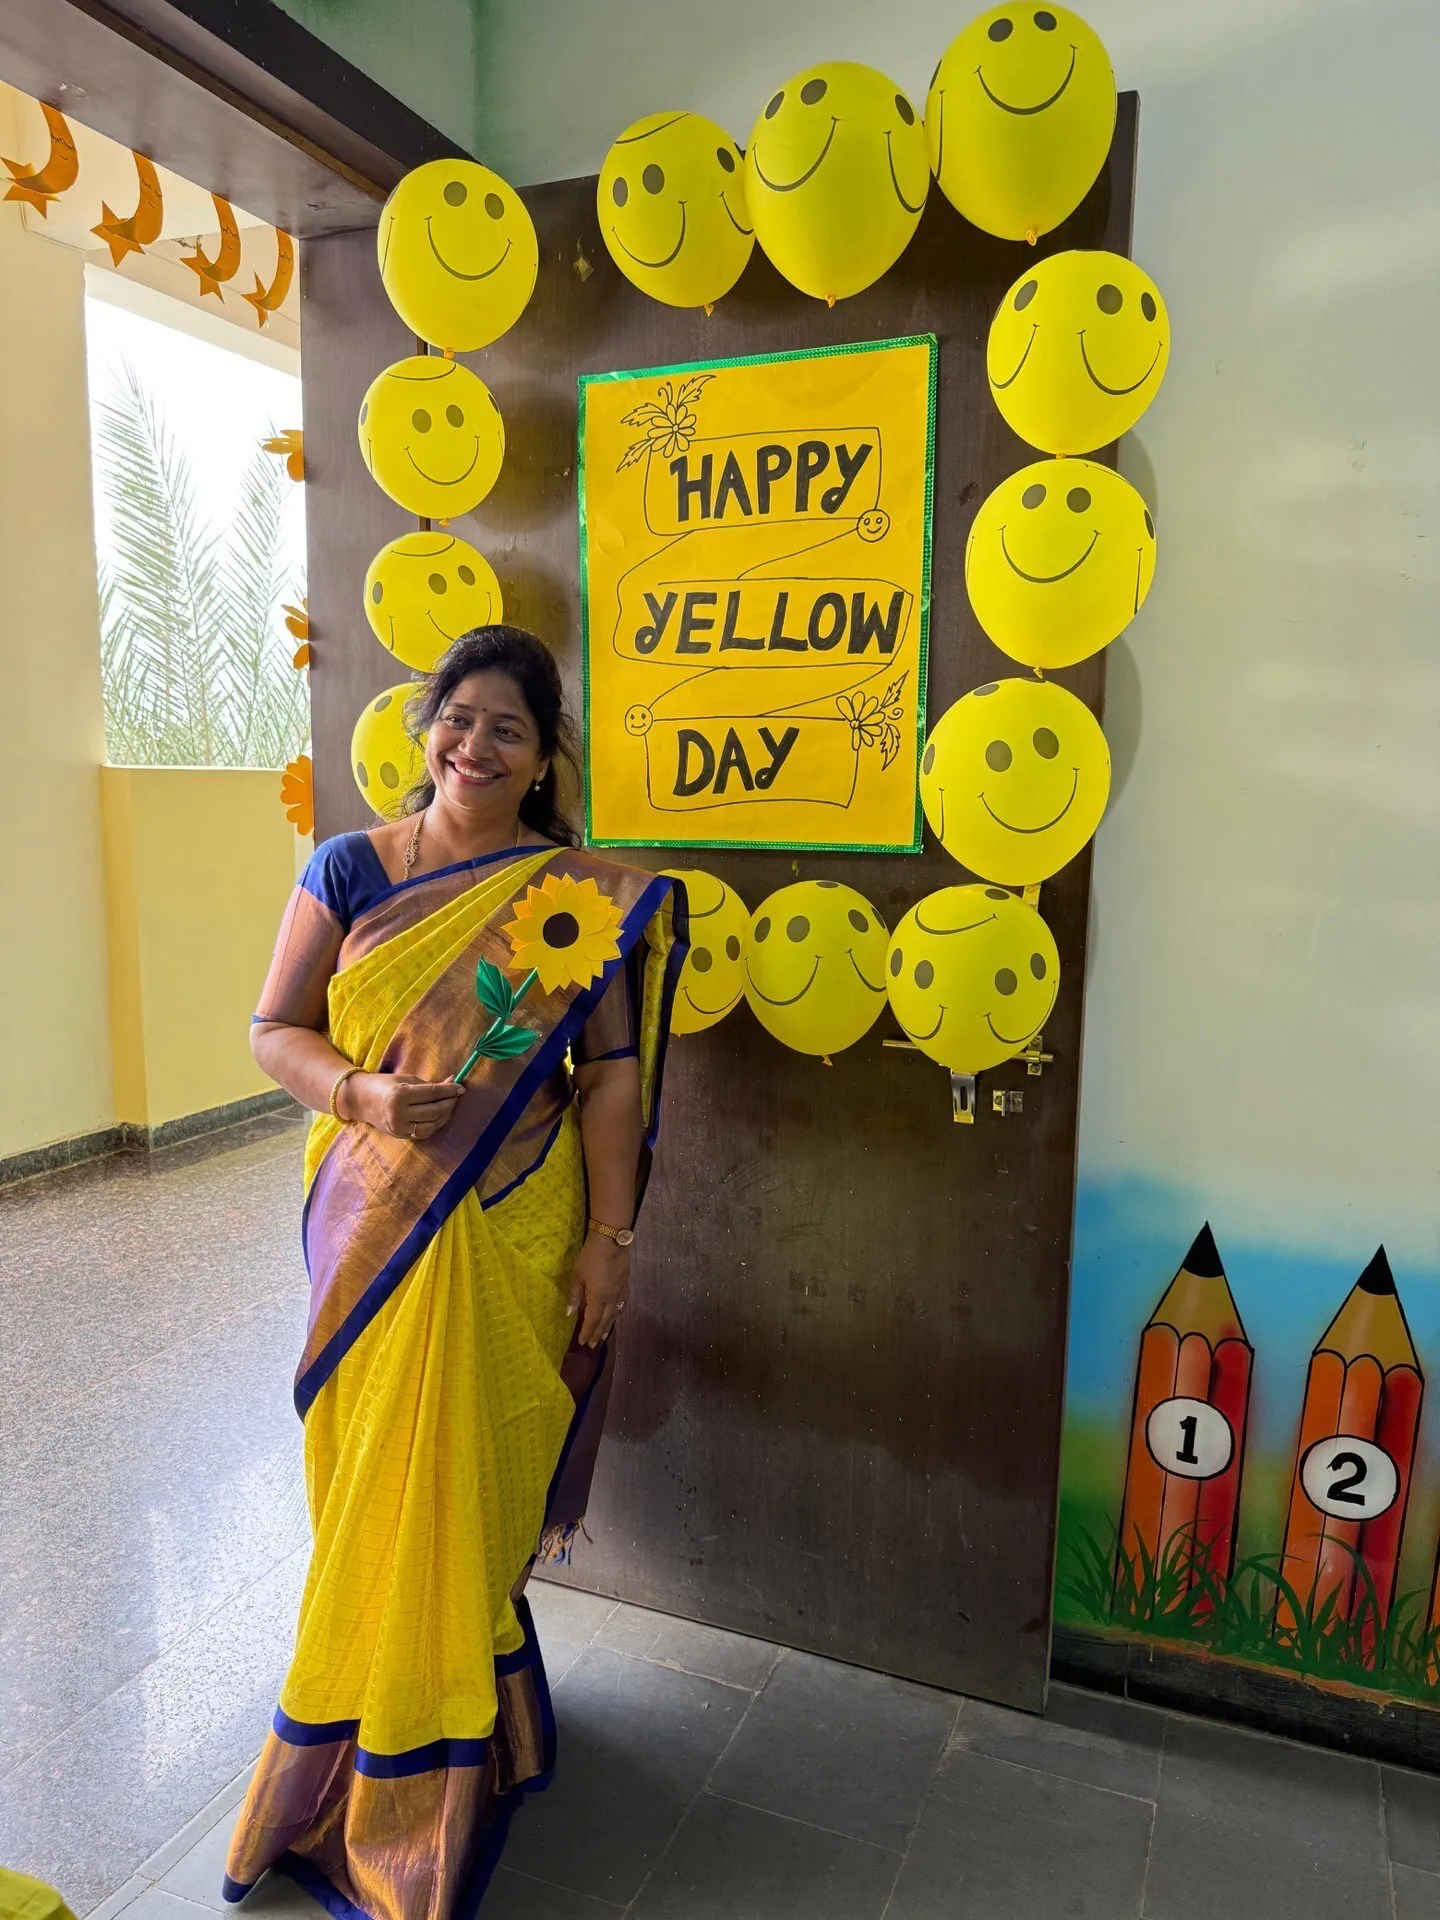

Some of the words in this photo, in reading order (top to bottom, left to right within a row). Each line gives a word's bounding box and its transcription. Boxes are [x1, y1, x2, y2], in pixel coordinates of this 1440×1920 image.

[669, 440, 873, 523] HAPPY
[634, 591, 905, 655] YELLOW
[672, 726, 800, 798] DAY
[1175, 1415, 1199, 1465] 1
[1326, 1452, 1368, 1506] 2
